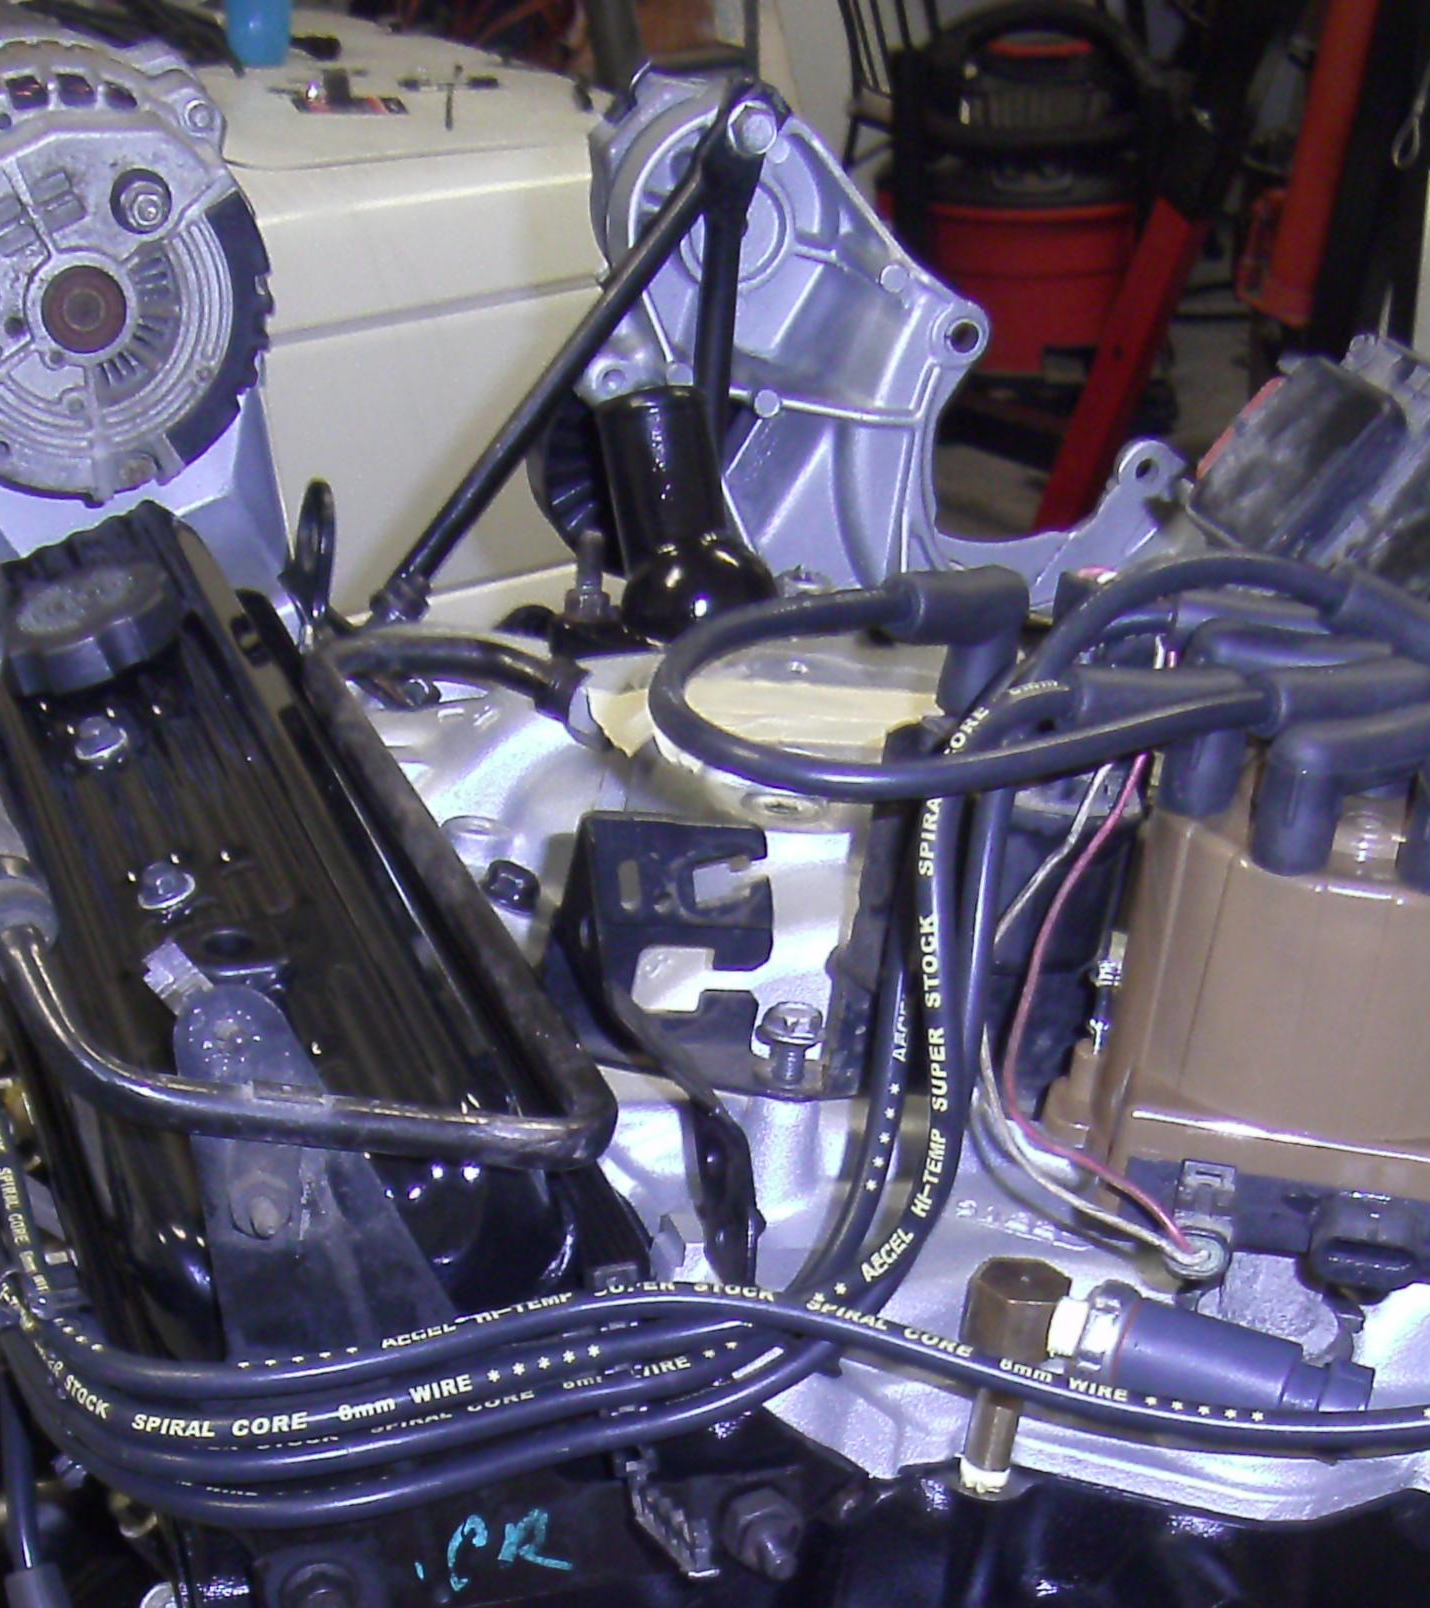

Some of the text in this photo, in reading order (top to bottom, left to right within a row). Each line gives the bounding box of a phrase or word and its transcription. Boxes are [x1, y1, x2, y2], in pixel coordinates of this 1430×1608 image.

[918, 797, 943, 877] SPIRA
[920, 914, 943, 1009] STOCK
[928, 1026, 949, 1112] SUPER
[910, 1127, 948, 1219] HI-TEMP
[8, 1213, 32, 1246] CORE
[903, 1325, 975, 1359] CORE
[998, 1356, 1054, 1384] 8mm
[1068, 1375, 1129, 1403] WIRE
[63, 1373, 112, 1420] STOCK
[131, 1413, 216, 1438] SPIRAL
[231, 1411, 309, 1438] CORE
[337, 1397, 397, 1423] 8mm
[408, 1373, 474, 1405] WIRE
